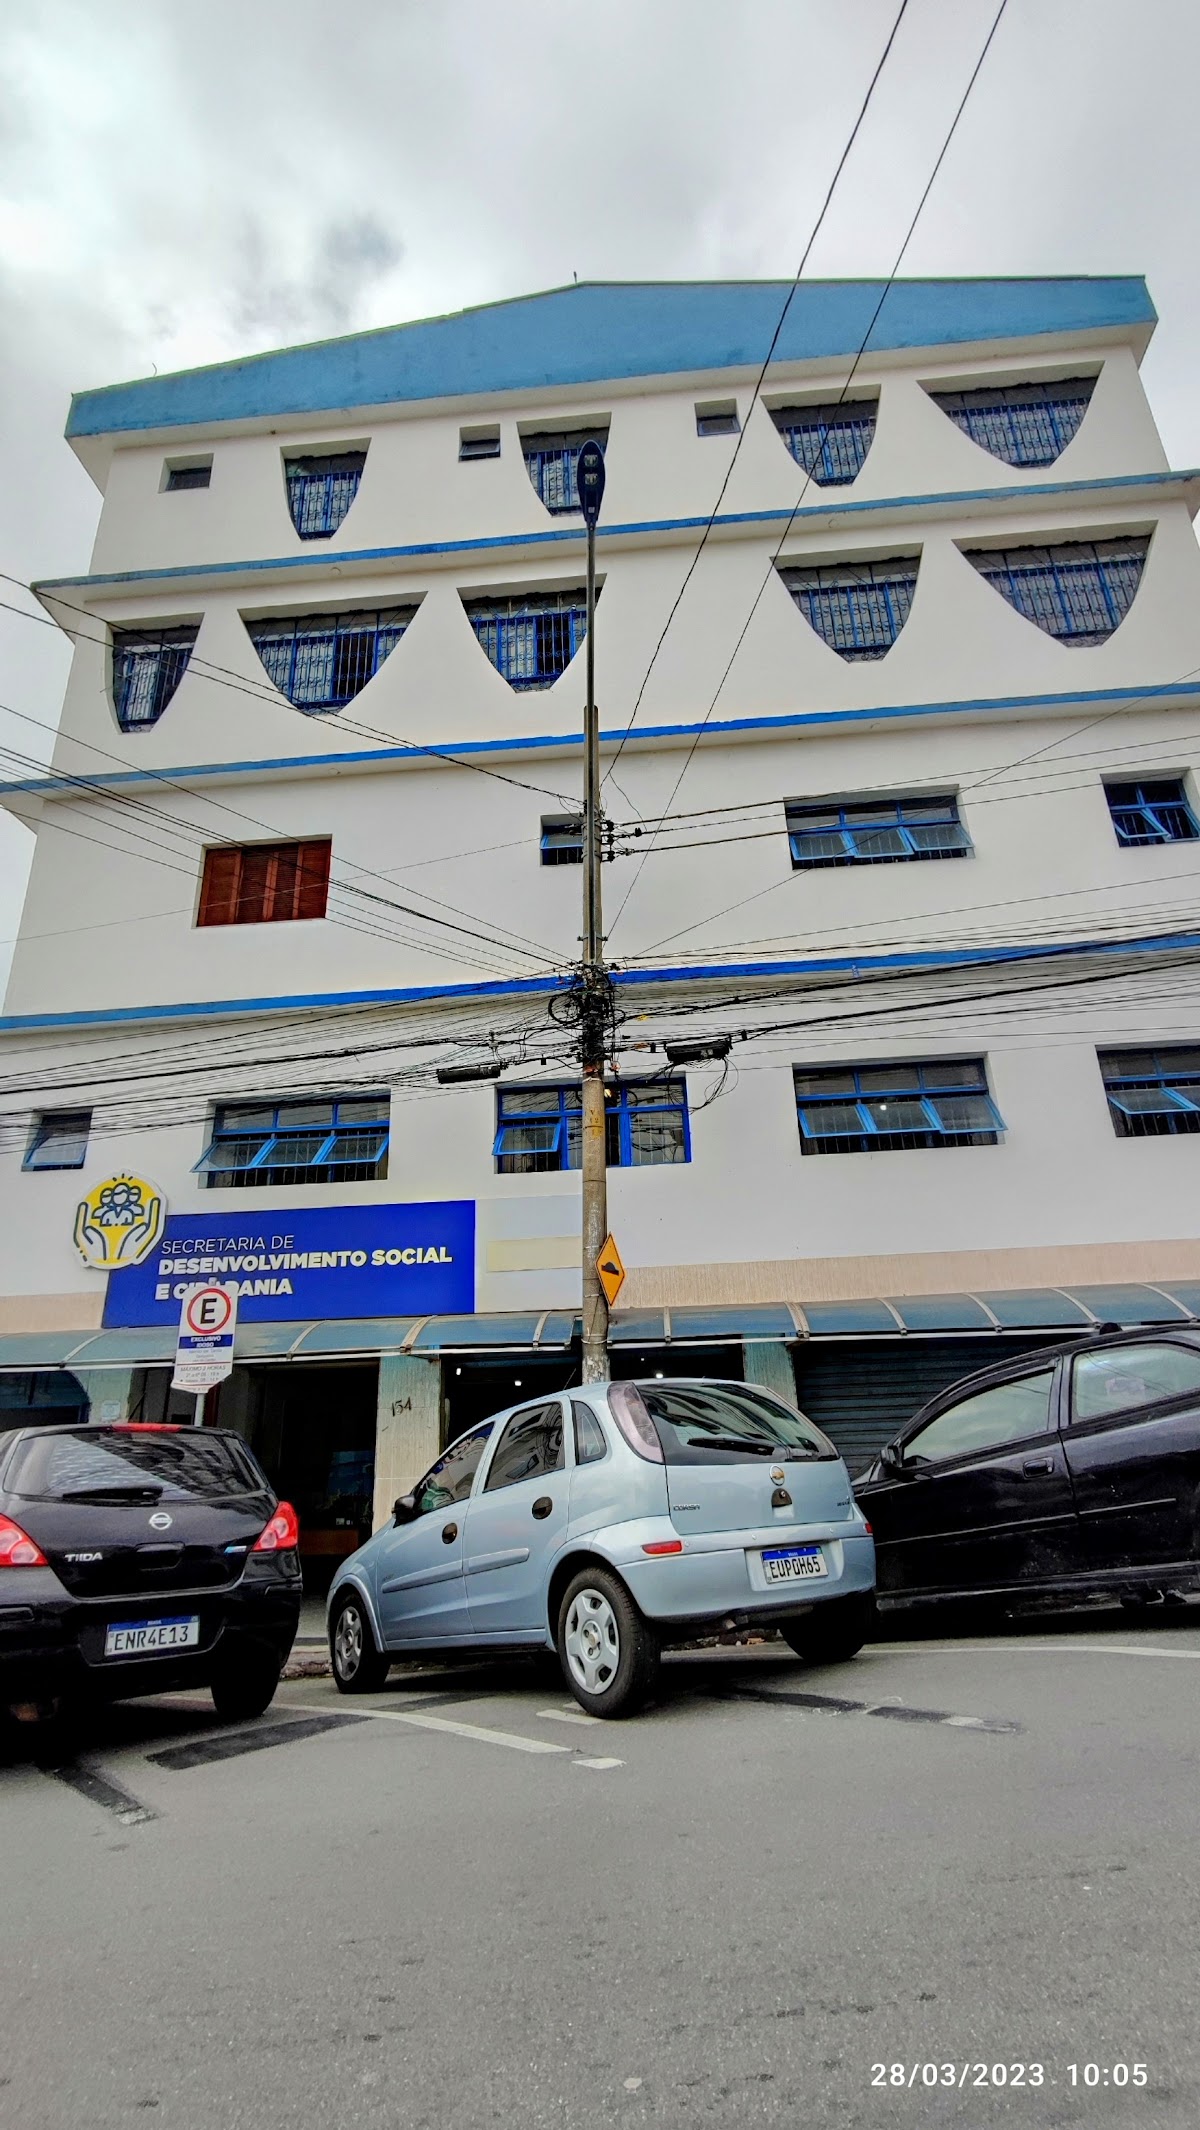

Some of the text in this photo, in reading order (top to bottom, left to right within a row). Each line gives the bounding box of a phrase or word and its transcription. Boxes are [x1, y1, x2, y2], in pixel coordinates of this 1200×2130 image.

[161, 1235, 294, 1255] SECRETARIA DE
[158, 1246, 453, 1276] DESENVOLVIMENTO SOCIAL
[155, 1283, 170, 1300] E
[200, 1298, 217, 1324] E
[64, 1552, 103, 1563] TIIDA
[114, 1626, 189, 1651] ENR4E13
